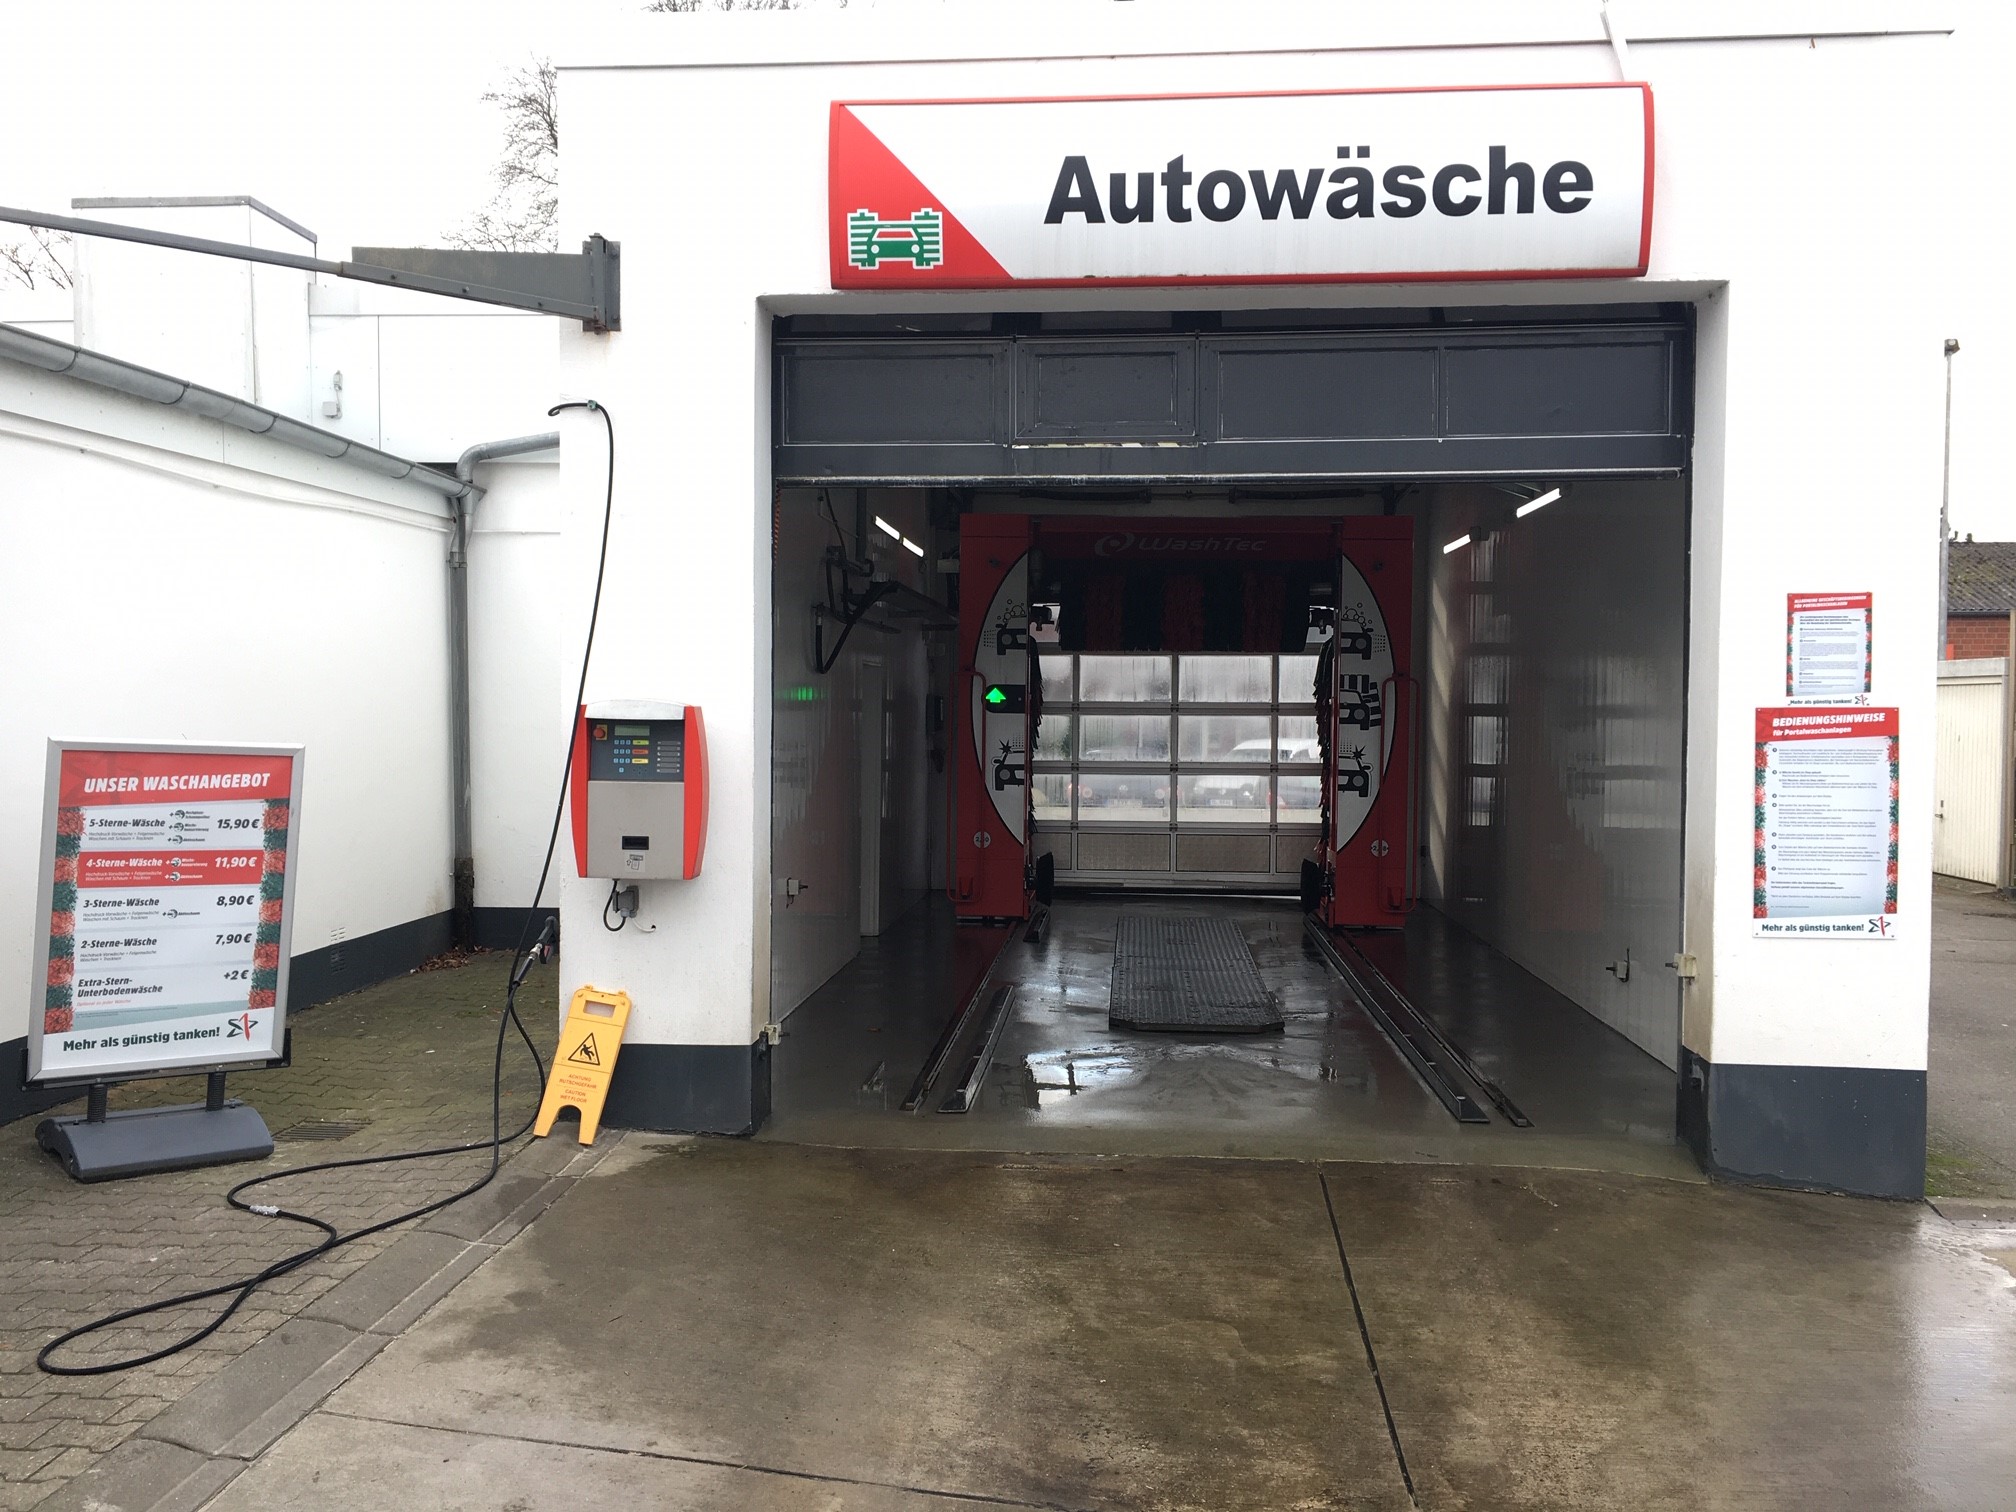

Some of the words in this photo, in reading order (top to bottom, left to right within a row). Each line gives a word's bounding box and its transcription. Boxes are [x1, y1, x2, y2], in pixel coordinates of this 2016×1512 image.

[1043, 145, 1594, 224] Autowäsche
[1138, 536, 1267, 552] WashTec
[1772, 712, 1886, 727] BEDIENUNGSHINWEISE
[1773, 728, 1783, 736] für
[1784, 727, 1852, 736] Portalwaschanlagen
[84, 776, 139, 794] UNSER
[143, 772, 271, 791] WASCHANGEBOT
[88, 818, 166, 828] 5-Sterne-Wäsche
[217, 819, 250, 830] 15,90
[251, 819, 260, 829] €
[86, 858, 162, 868] 4-Sterne-Wäsche
[215, 857, 247, 868] 11,90
[248, 857, 257, 867] €
[83, 898, 160, 908] 3-Sterne-Wäsche
[216, 895, 244, 907] 8,90
[246, 895, 254, 905] €
[1800, 924, 1830, 932] günstig
[1832, 924, 1864, 932] tanken!
[81, 938, 157, 949] 2-Sterne-Wäsche
[215, 934, 242, 946] 7,90
[244, 934, 252, 943] €
[224, 971, 238, 980] +2
[241, 970, 249, 979] €
[78, 978, 132, 987] Extra-Stern-
[77, 985, 163, 998] Unterbodenwäsche
[63, 1040, 97, 1051] Mehr
[100, 1037, 119, 1048] als
[123, 1031, 170, 1047] günstig
[173, 1027, 220, 1041] tanken!
[559, 1078, 597, 1089] RUTSCHGEFAHR
[568, 1074, 592, 1082] ACHTUNG
